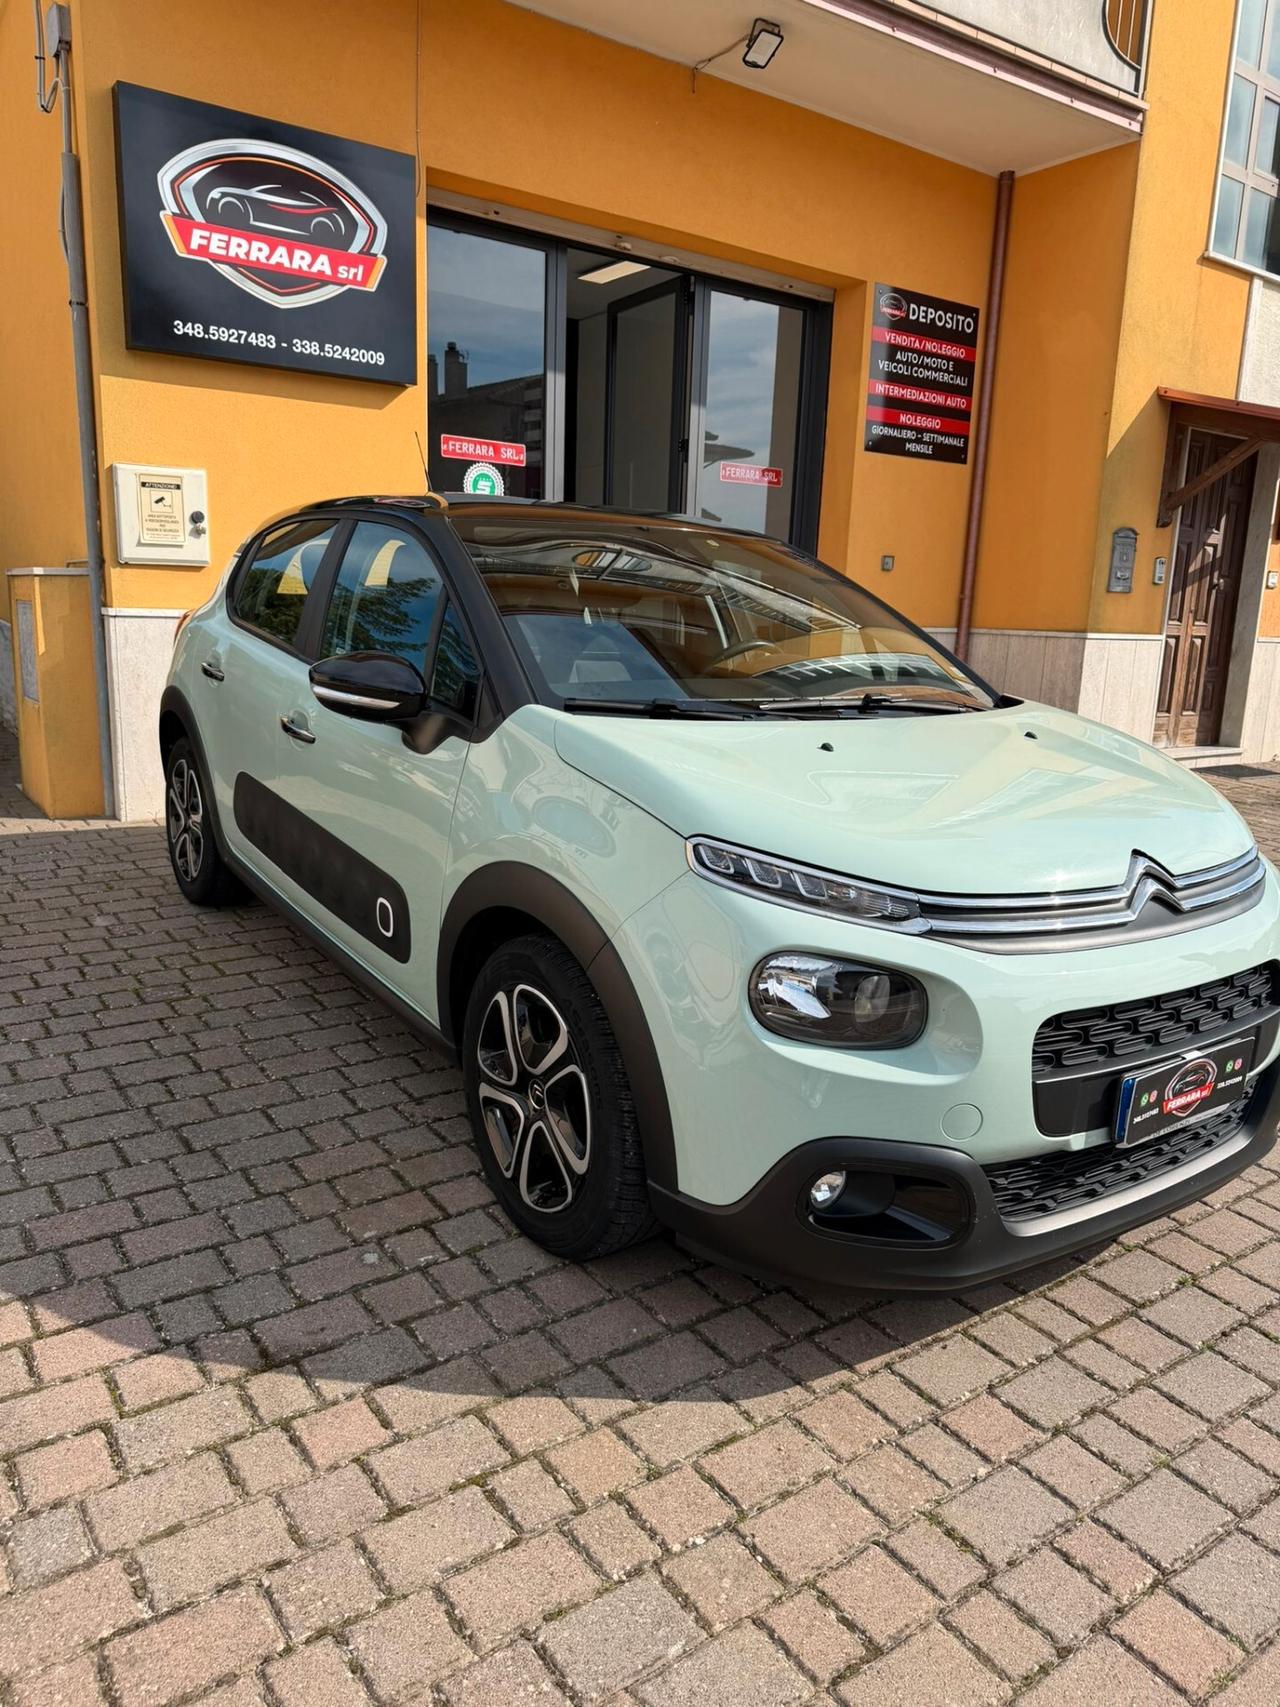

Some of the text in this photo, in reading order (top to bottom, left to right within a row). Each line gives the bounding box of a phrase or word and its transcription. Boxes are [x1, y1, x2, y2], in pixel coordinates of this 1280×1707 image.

[190, 229, 364, 283] FERRARA srl
[909, 304, 974, 333] DEPOSITO
[173, 319, 277, 350] 348.5927483
[292, 338, 386, 366] 338.5242009
[878, 359, 969, 387] VEICOLI COMMERCIALI
[949, 361, 955, 372] E
[875, 382, 967, 409] INTERMEDIAZIONI AUTO
[899, 413, 942, 429] NOLEGGIO
[871, 425, 917, 441] GIORNALIERO
[922, 432, 965, 448] SETTIMANALE
[448, 440, 519, 460] FERRARA SRL
[905, 443, 933, 455] MENSILE
[725, 466, 778, 482] FERRARA SRL
